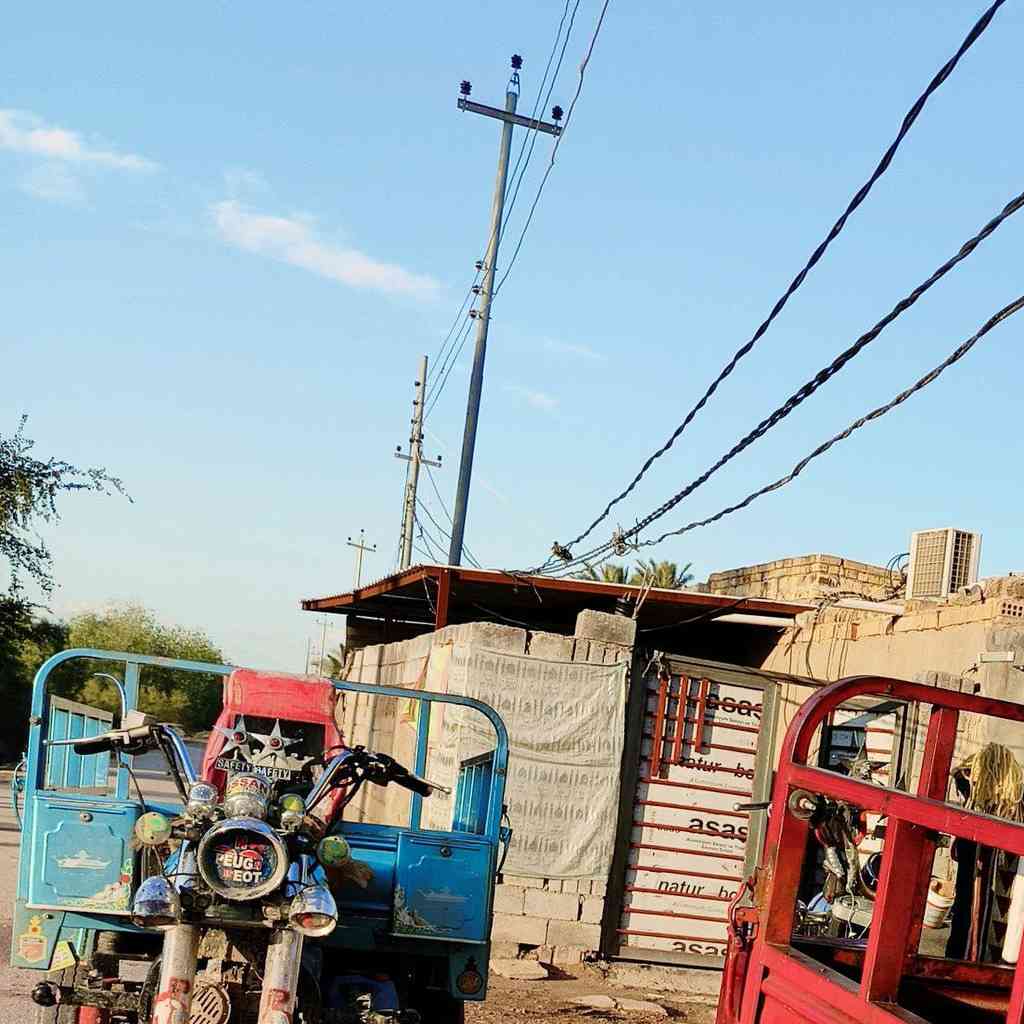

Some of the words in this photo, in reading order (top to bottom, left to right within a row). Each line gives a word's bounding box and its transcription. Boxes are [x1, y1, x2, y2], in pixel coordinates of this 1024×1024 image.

[217, 759, 252, 773] SAFETY
[255, 766, 290, 780] SAFETY
[658, 880, 704, 896] natur
